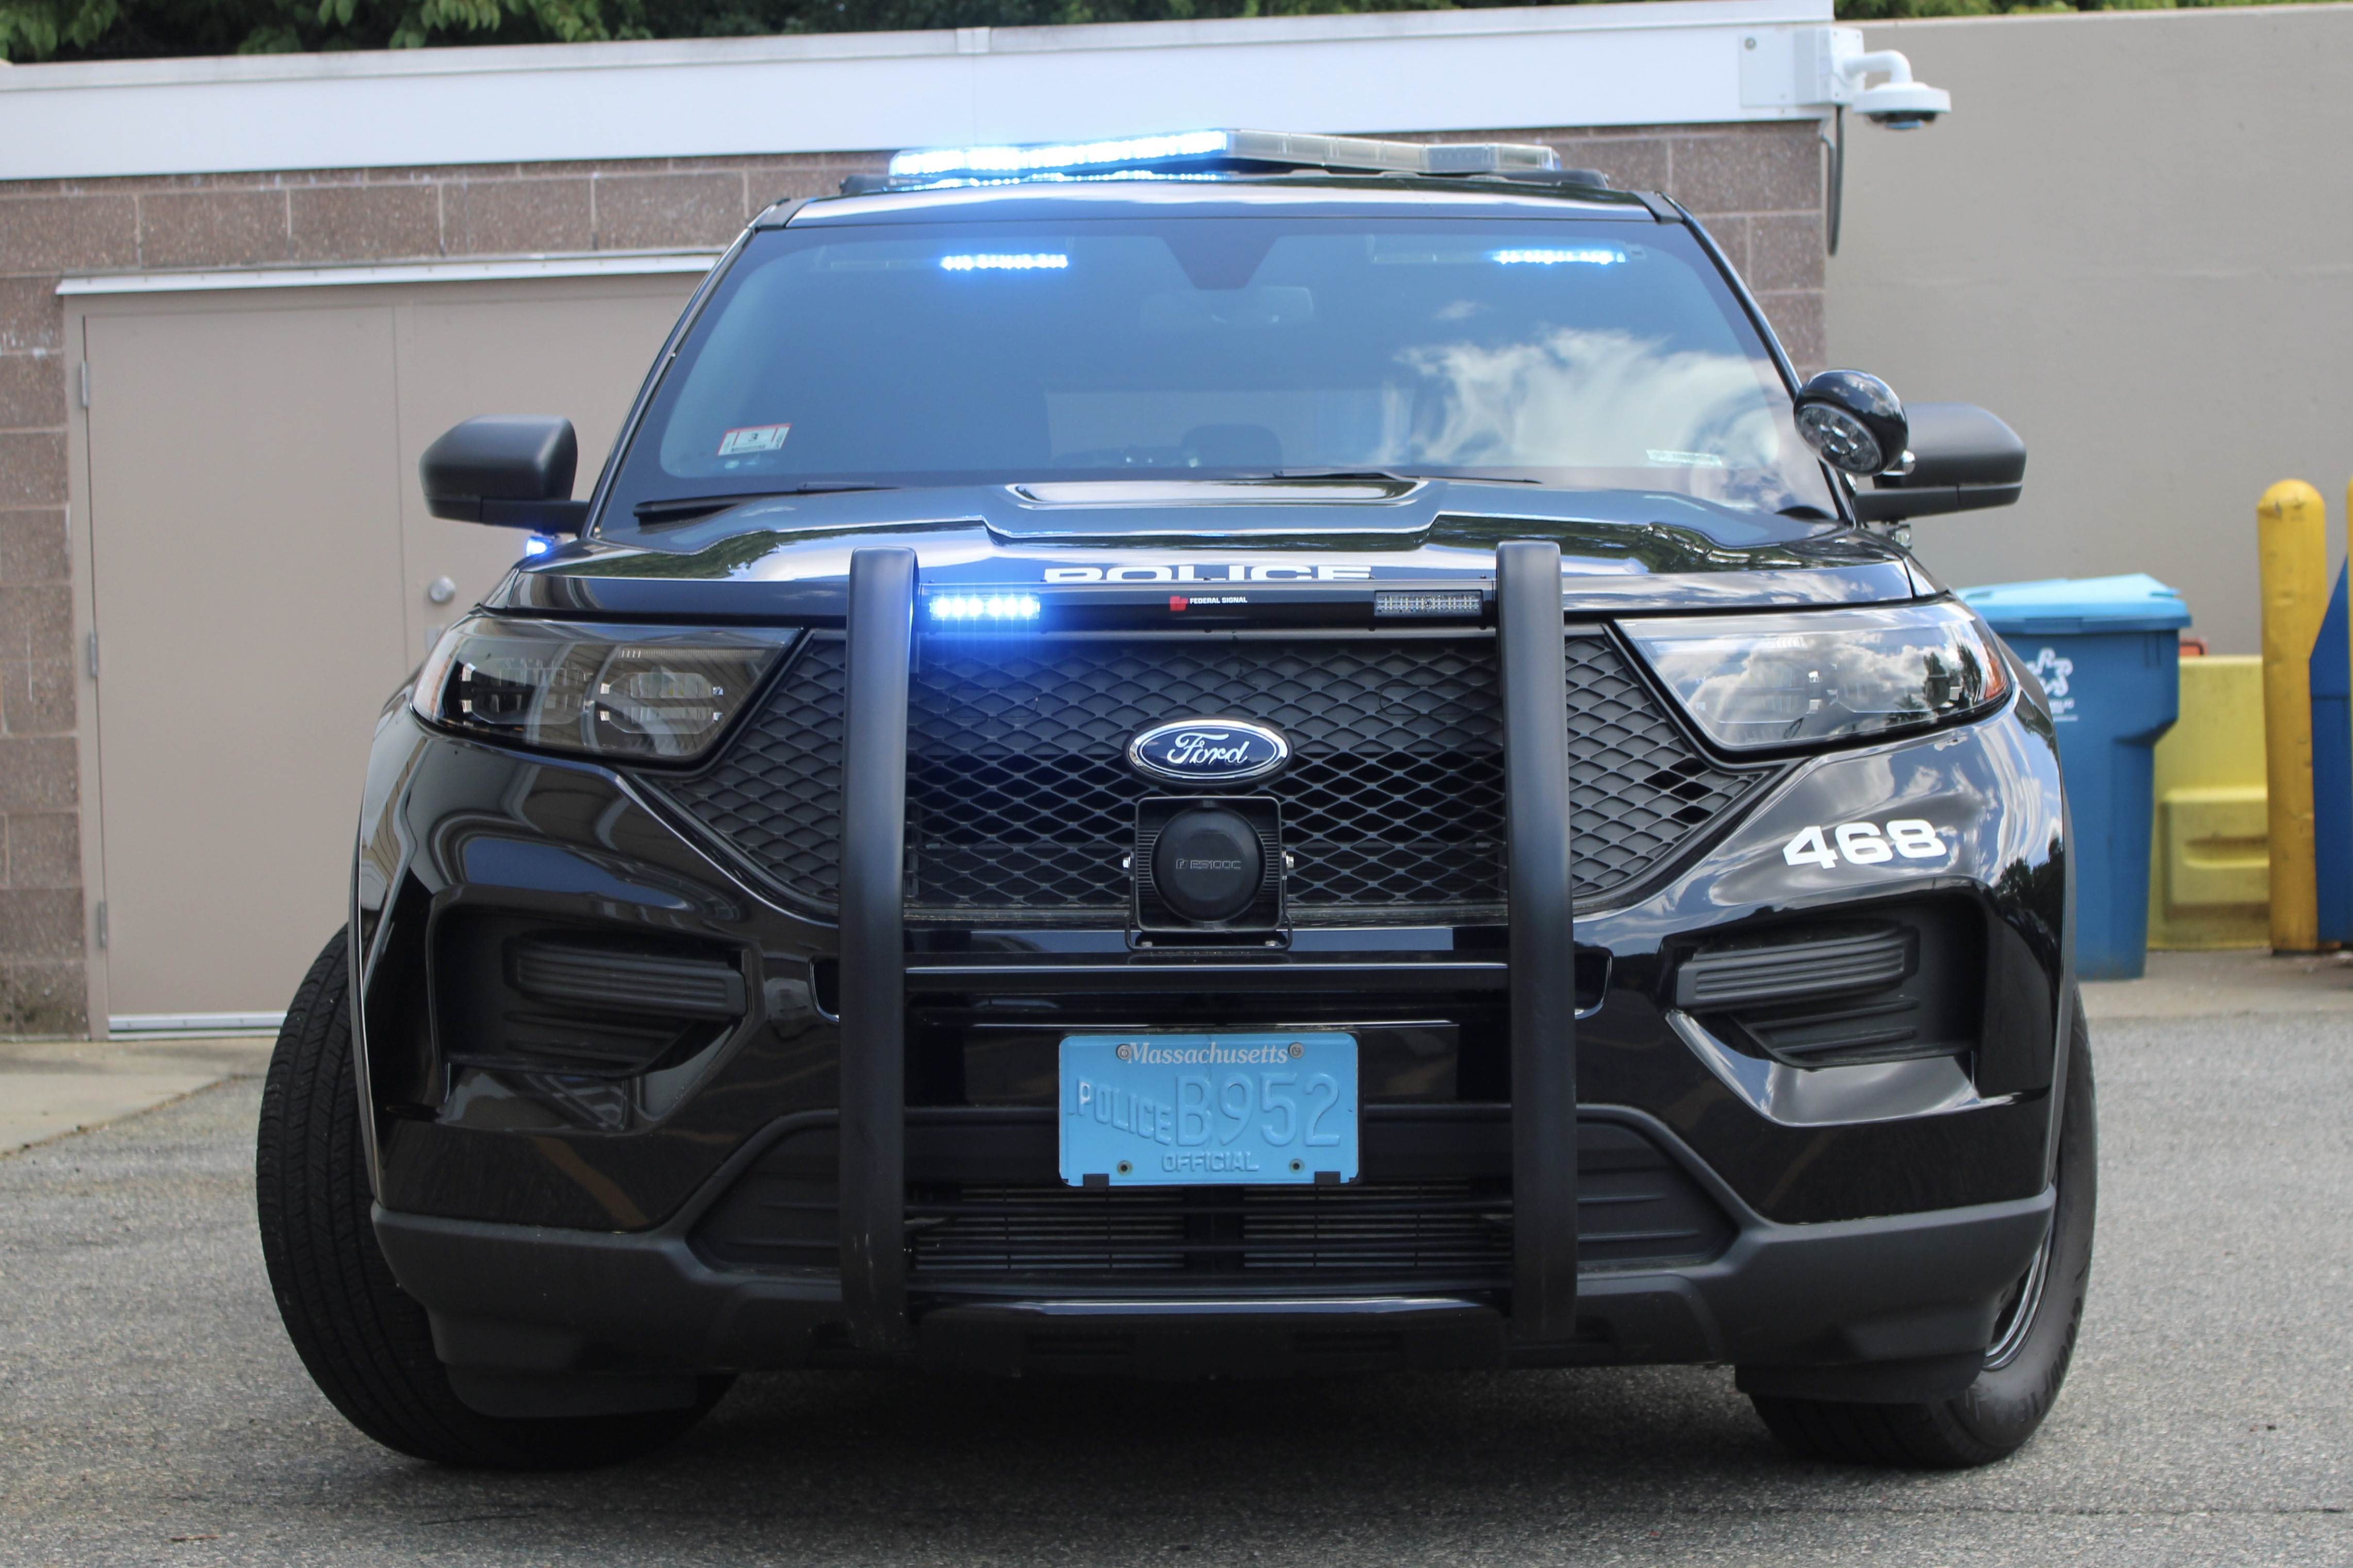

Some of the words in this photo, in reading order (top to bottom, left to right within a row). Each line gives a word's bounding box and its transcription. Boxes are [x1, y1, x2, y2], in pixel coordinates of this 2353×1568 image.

[1044, 565, 1372, 581] POLICE
[1166, 732, 1250, 765] Ford
[1782, 819, 1947, 869] 468
[1190, 859, 1241, 870] ES100C
[1127, 1042, 1288, 1065] Massachusetts
[1077, 1077, 1171, 1146] POLICE
[1175, 1072, 1340, 1148] B952
[1161, 1151, 1259, 1173] OFFICIAL
